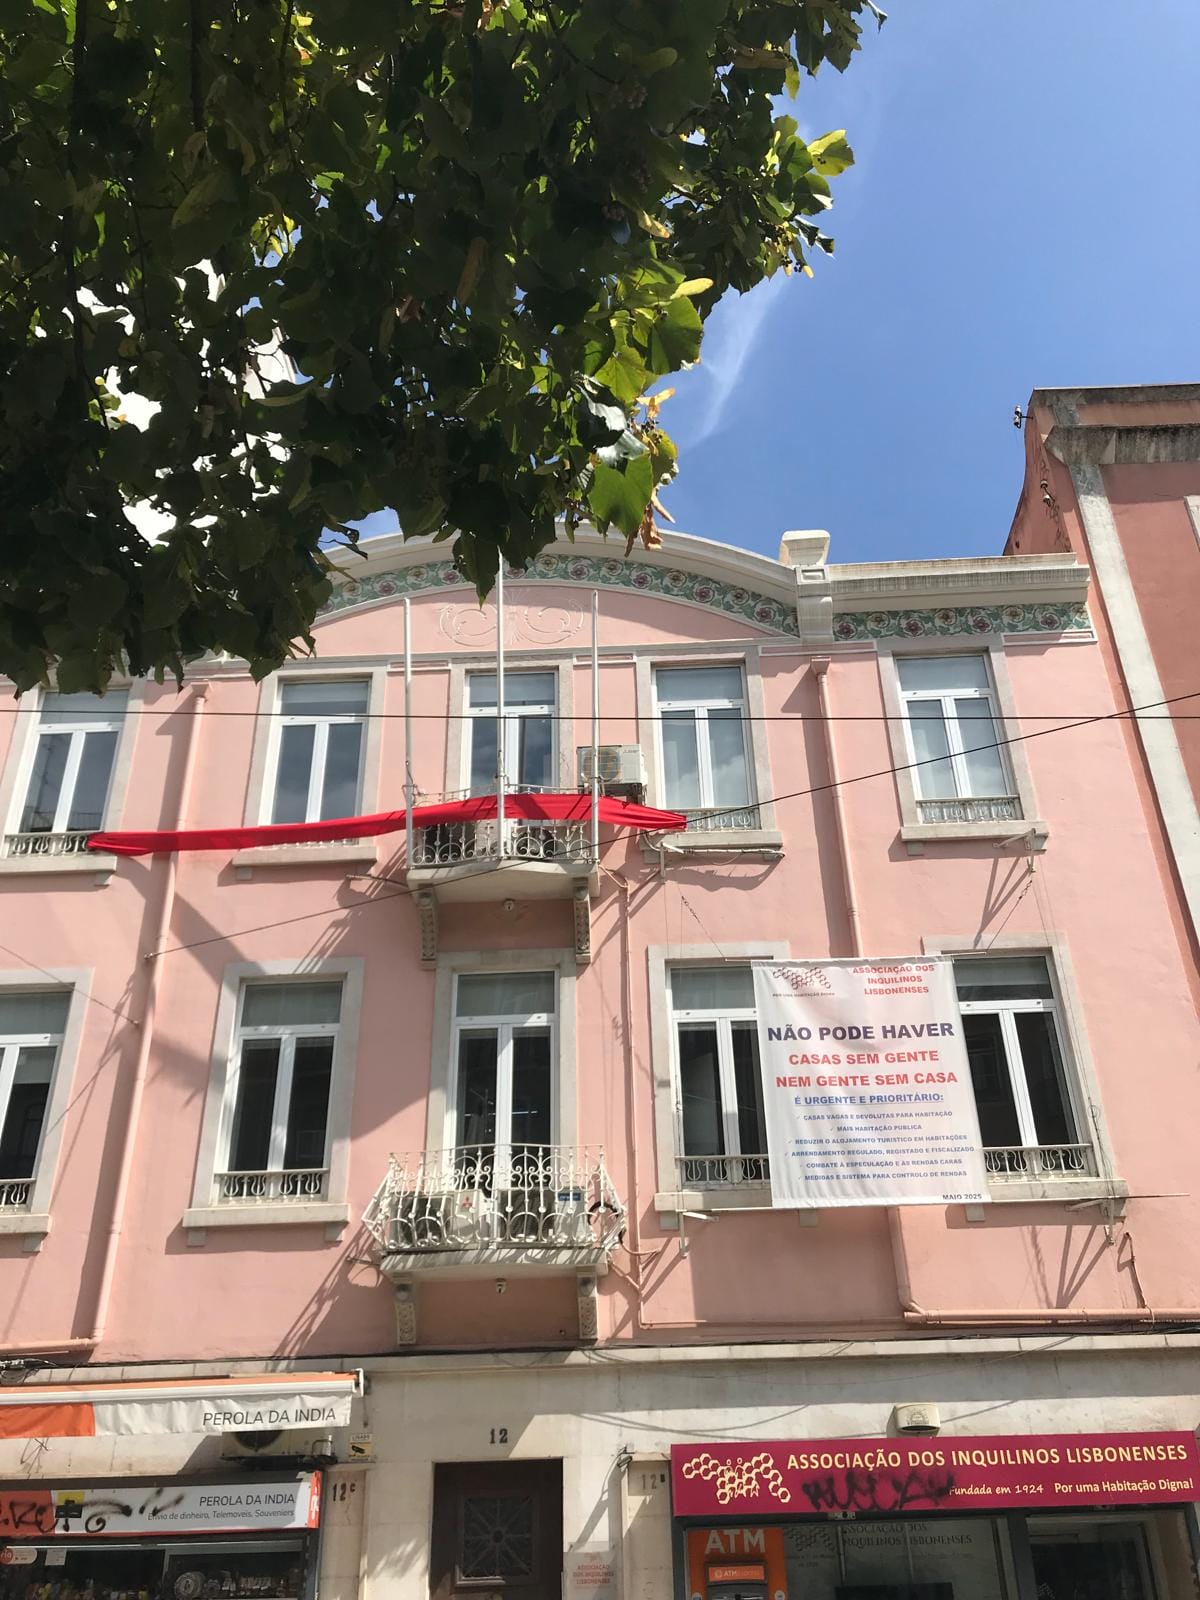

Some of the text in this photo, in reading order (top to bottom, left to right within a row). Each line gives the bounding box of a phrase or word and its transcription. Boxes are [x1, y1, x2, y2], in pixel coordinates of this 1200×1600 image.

[867, 975, 923, 984] INQUILINOS
[864, 986, 929, 995] LISBONENSES
[767, 1022, 955, 1041] NÃO PODE HAVER
[788, 1050, 940, 1066] CASAS SEM GENTE
[776, 1071, 958, 1088] NEM GENTE SEM CASA
[794, 1092, 944, 1105] É URGENTE E PRIORITÁRIO:
[203, 1408, 336, 1426] PEROLA DA INDIA
[490, 1428, 508, 1444] 12
[787, 1445, 1188, 1471] ASSOCIAÇÃO DOS INQUILINOS LISBONENSES
[1015, 1484, 1044, 1494] 1924
[1054, 1482, 1072, 1493] Por
[1076, 1484, 1100, 1492] uma
[1103, 1478, 1156, 1494] Habitação
[1159, 1478, 1194, 1492] Digna!
[200, 1494, 294, 1506] PEROLA DA INDIA
[169, 1512, 178, 1520] de
[705, 1529, 766, 1554] ATM
